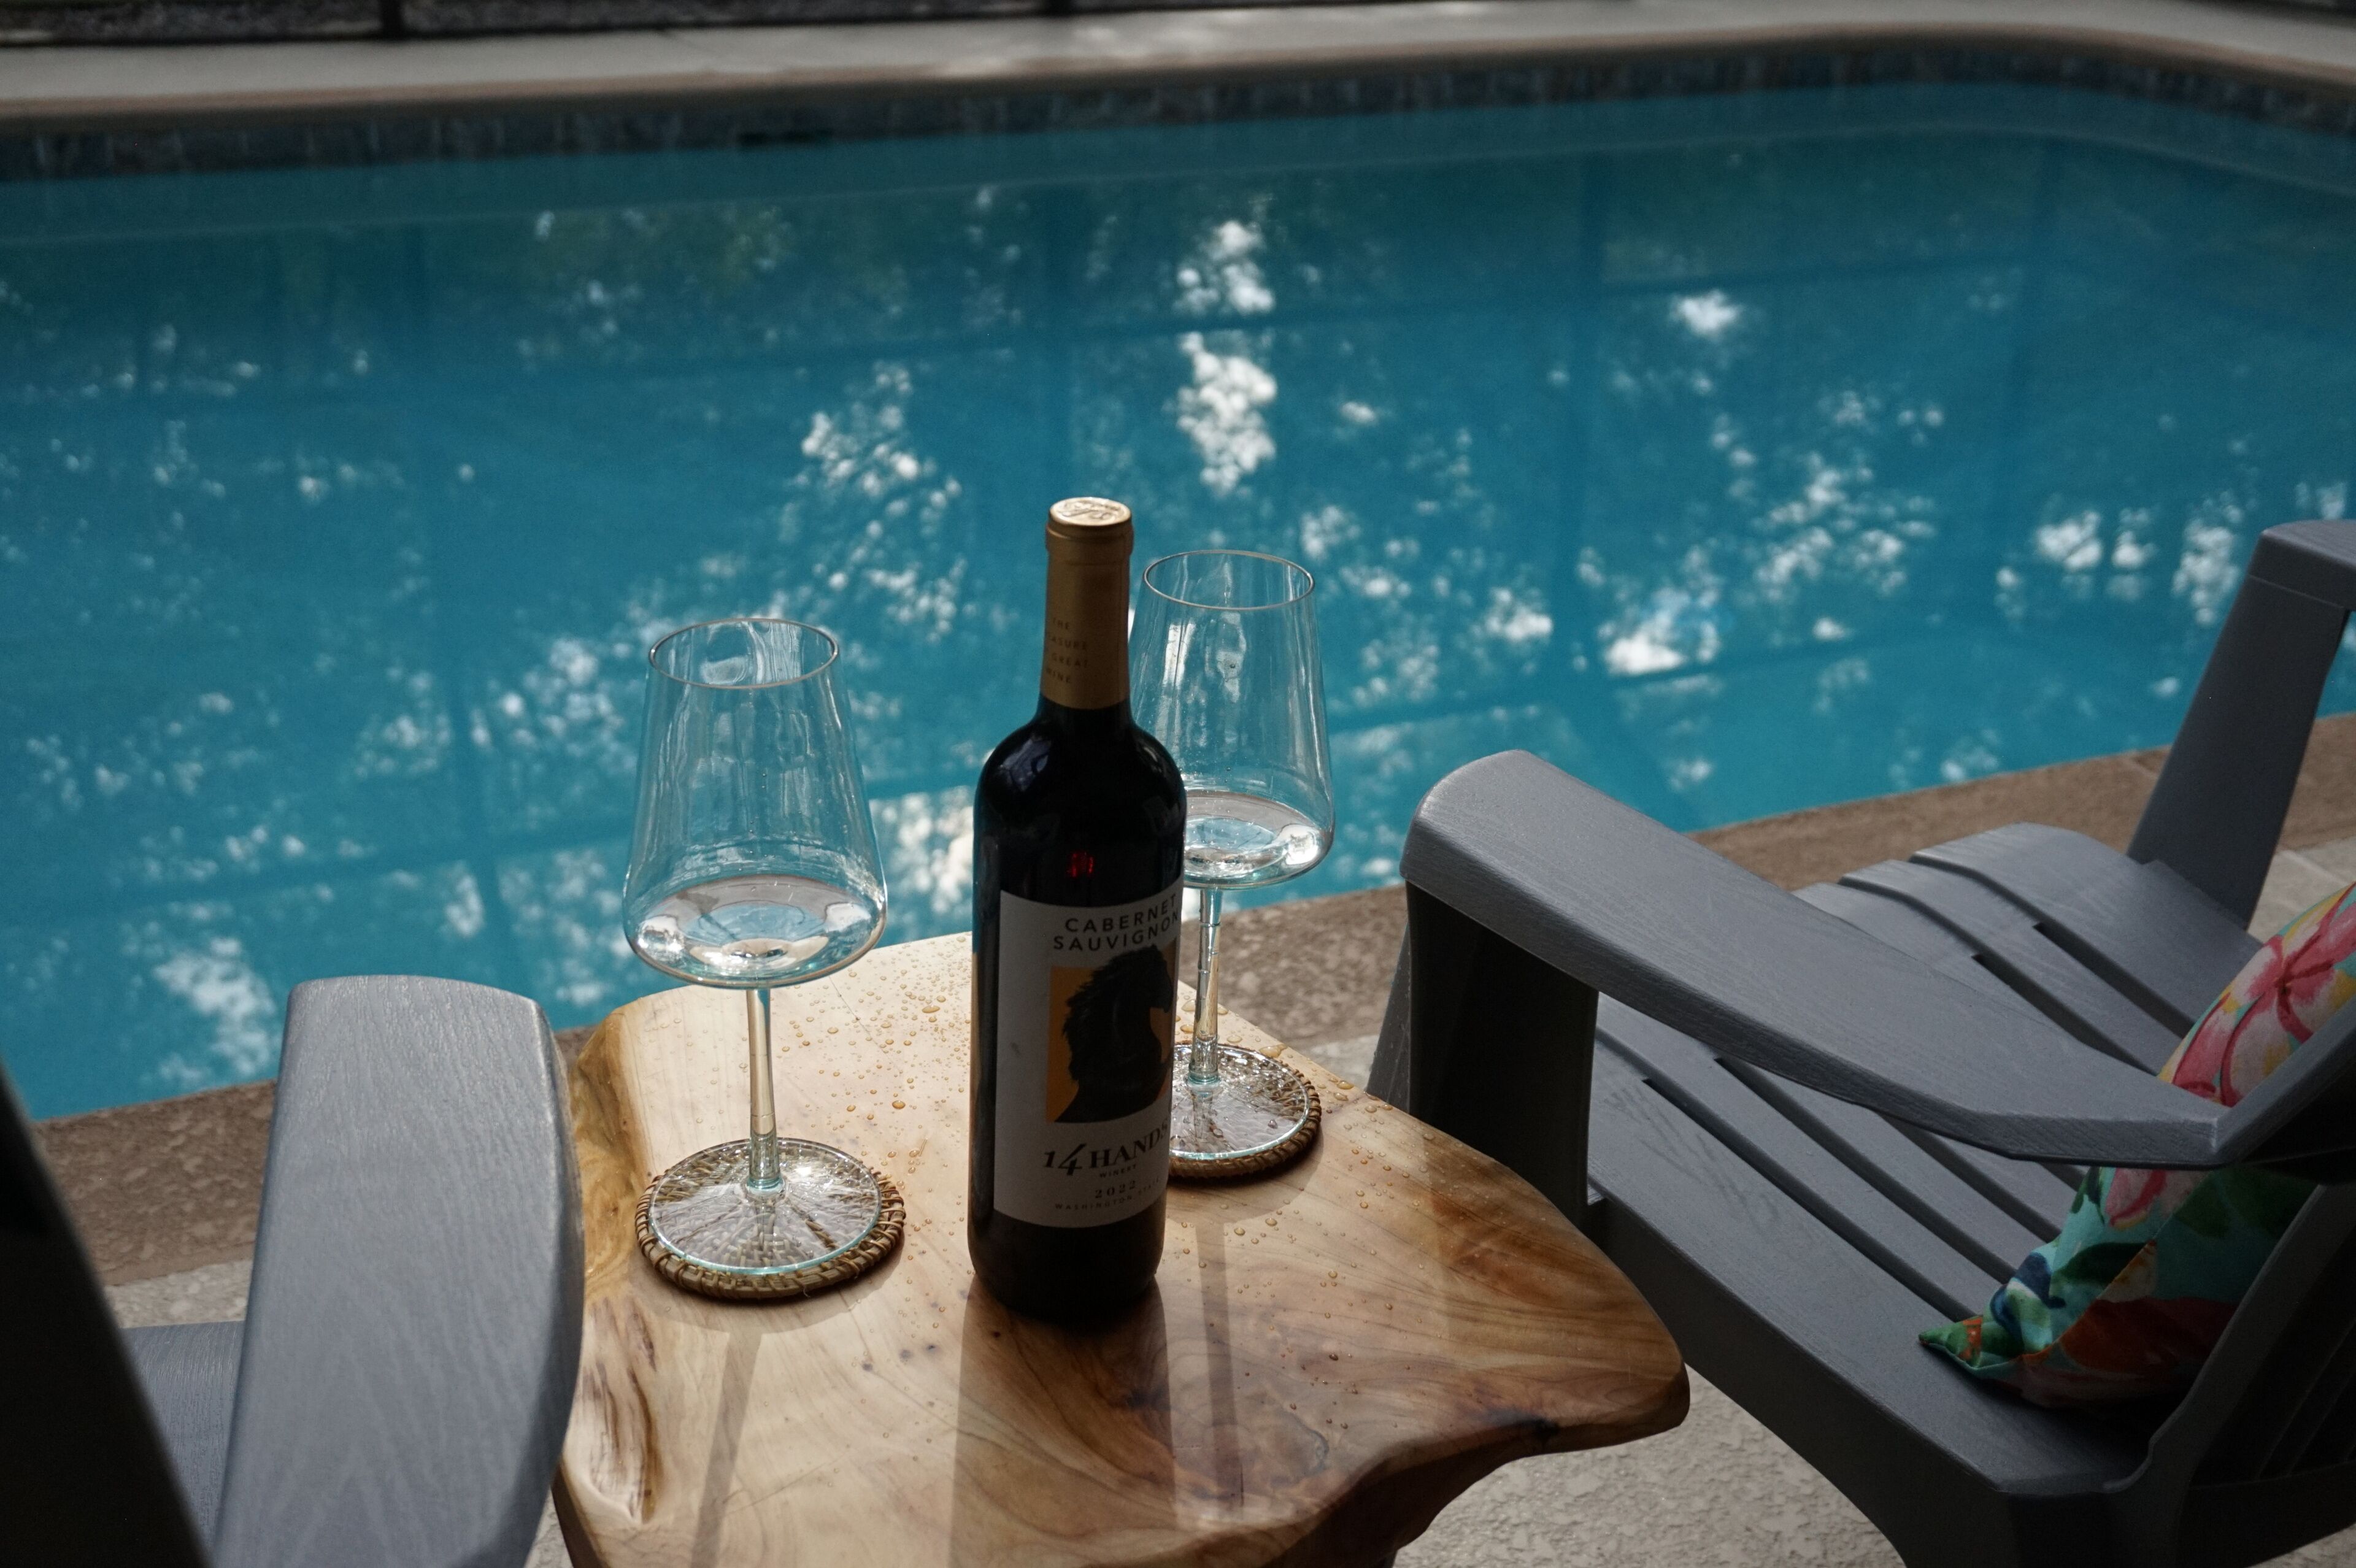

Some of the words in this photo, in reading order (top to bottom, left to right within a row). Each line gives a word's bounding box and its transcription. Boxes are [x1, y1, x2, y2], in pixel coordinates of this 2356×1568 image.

[1051, 652, 1088, 669] GREAT
[1064, 893, 1176, 932] CABERNET
[1053, 907, 1178, 951] SAUVIGNON
[1043, 1142, 1087, 1177] 14
[1099, 1164, 1137, 1178] WINERY
[1095, 1180, 1136, 1199] 2022
[1055, 1195, 1133, 1210] WASHINGTON
